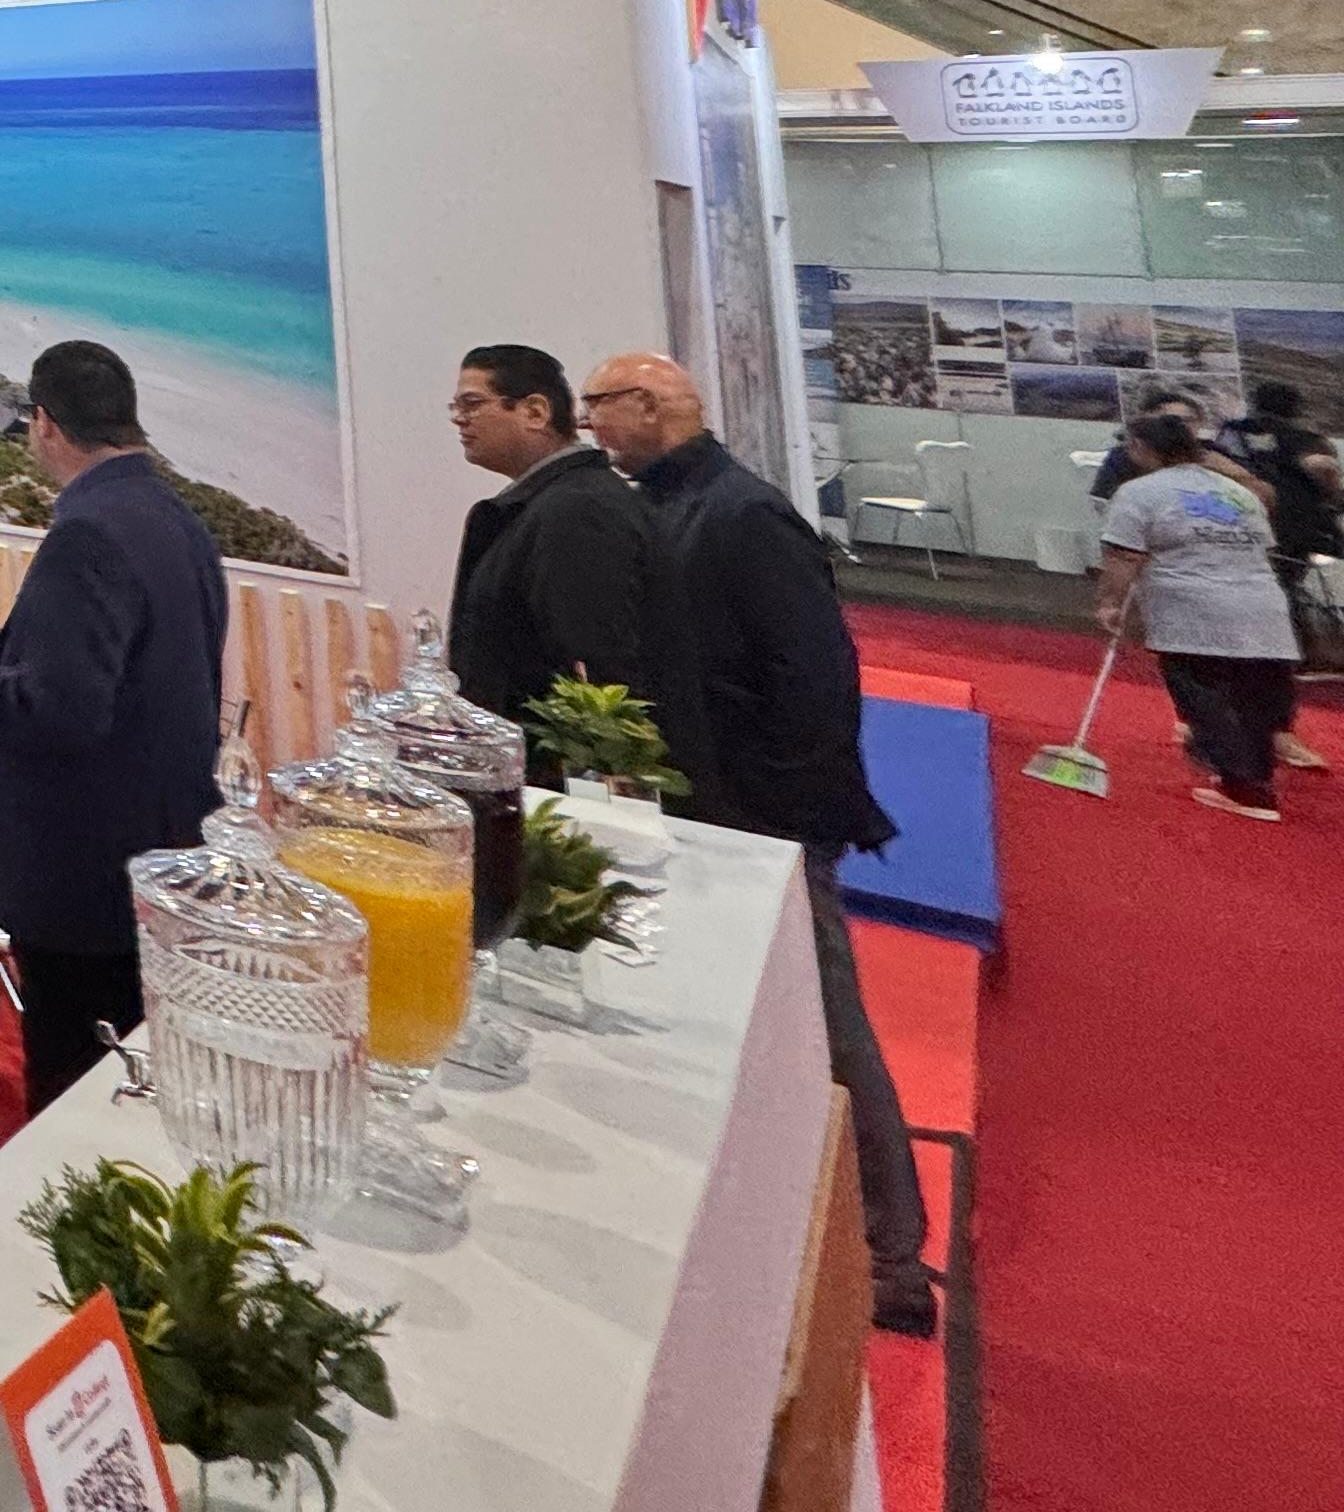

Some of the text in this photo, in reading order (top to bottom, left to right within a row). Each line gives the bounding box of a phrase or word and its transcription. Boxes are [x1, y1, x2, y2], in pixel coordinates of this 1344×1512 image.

[955, 99, 1126, 114] FALKLAND ISLANDS
[958, 114, 1127, 127] TOURIST BOARD
